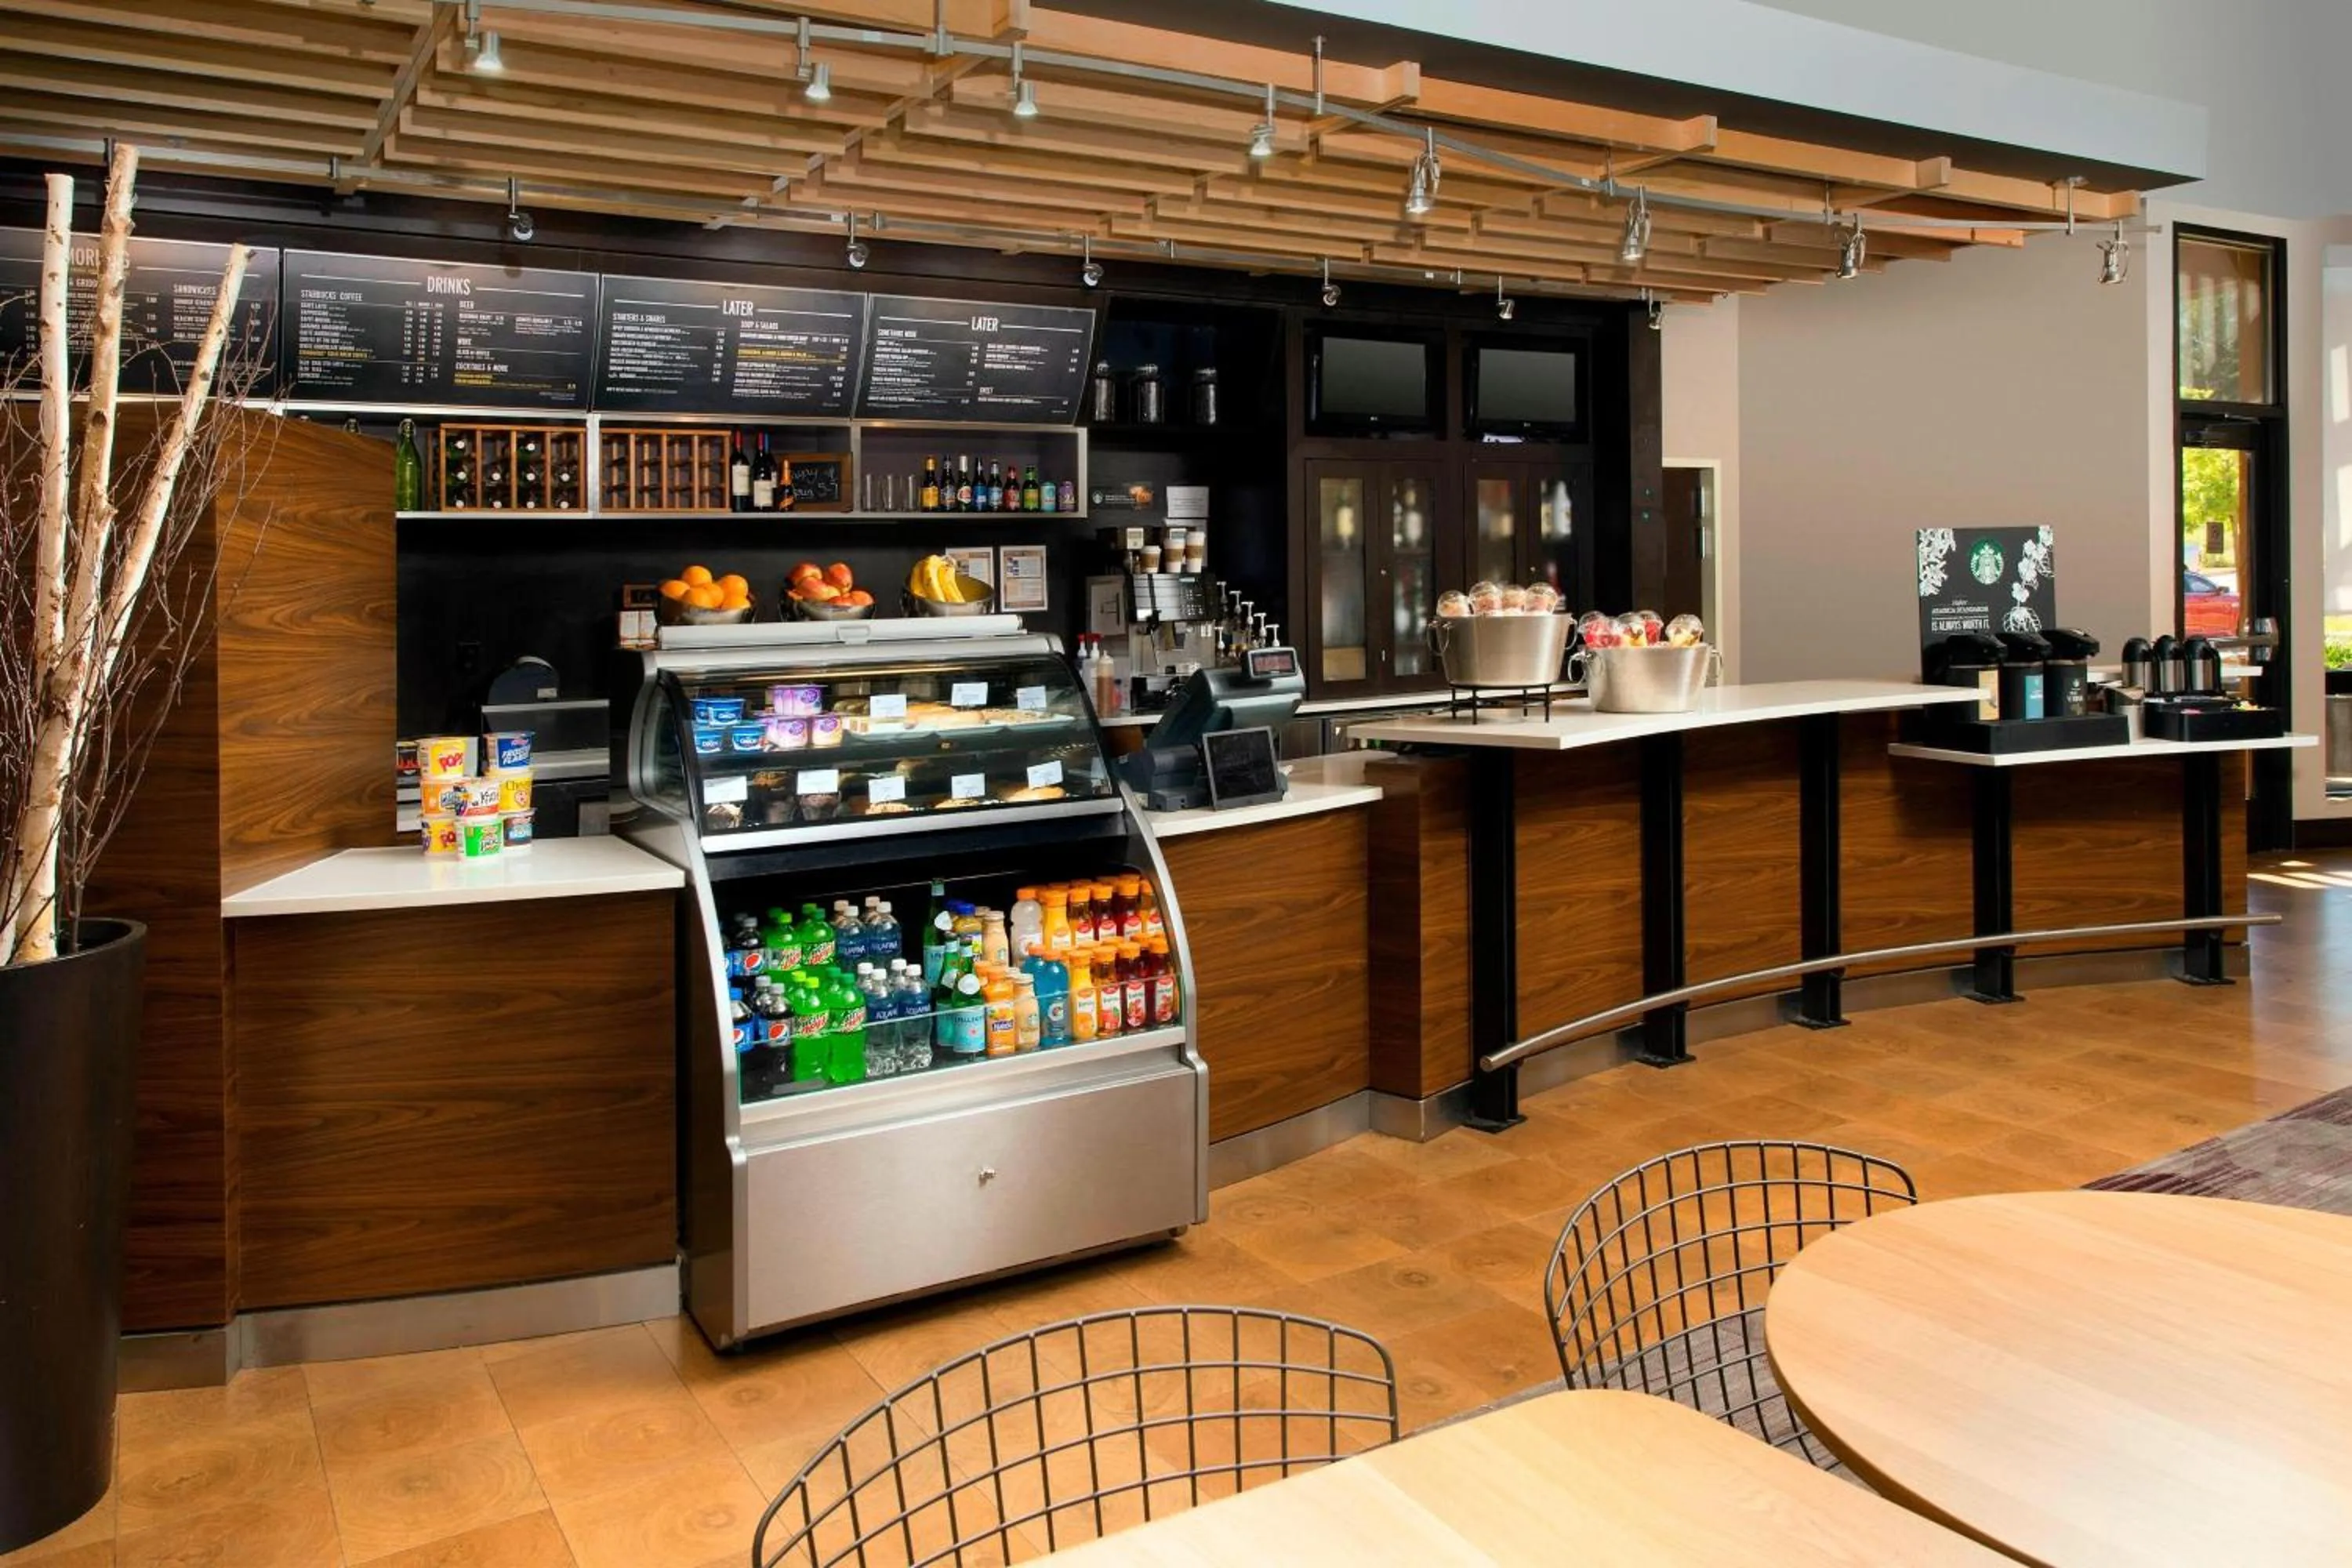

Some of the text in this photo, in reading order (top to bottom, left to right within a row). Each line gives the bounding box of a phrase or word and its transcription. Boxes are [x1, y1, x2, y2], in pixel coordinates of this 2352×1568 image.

[427, 276, 470, 296] DRINKS
[339, 292, 363, 302] COFFEE
[723, 299, 753, 316] LATER
[971, 315, 999, 332] LATER
